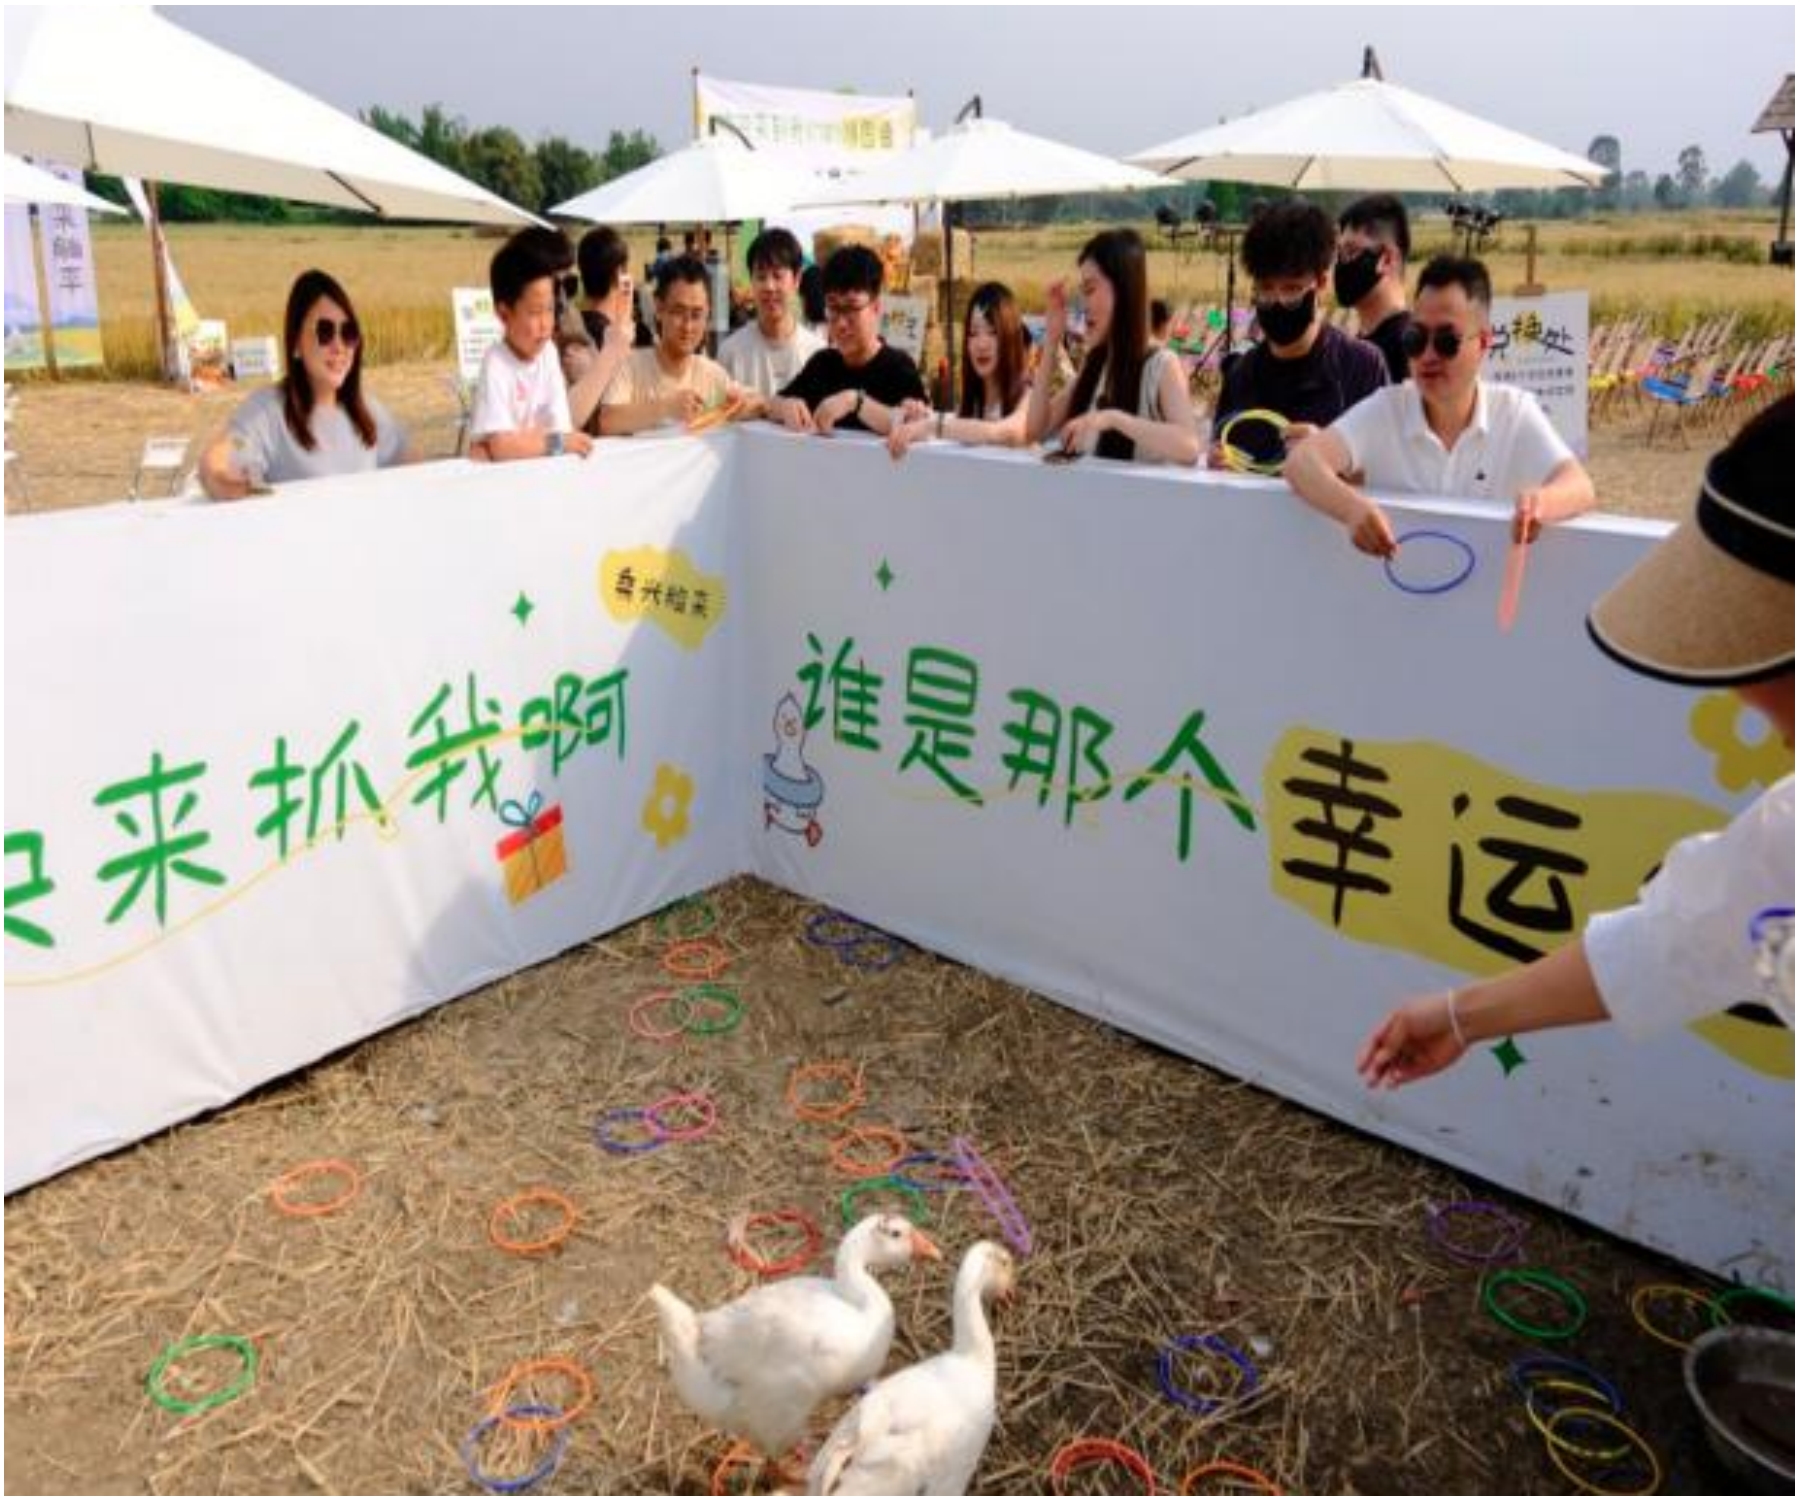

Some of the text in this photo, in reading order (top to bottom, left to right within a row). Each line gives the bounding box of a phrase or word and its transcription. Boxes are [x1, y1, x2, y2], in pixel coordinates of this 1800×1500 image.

[796, 634, 1788, 1028] 谁是那个幸运
